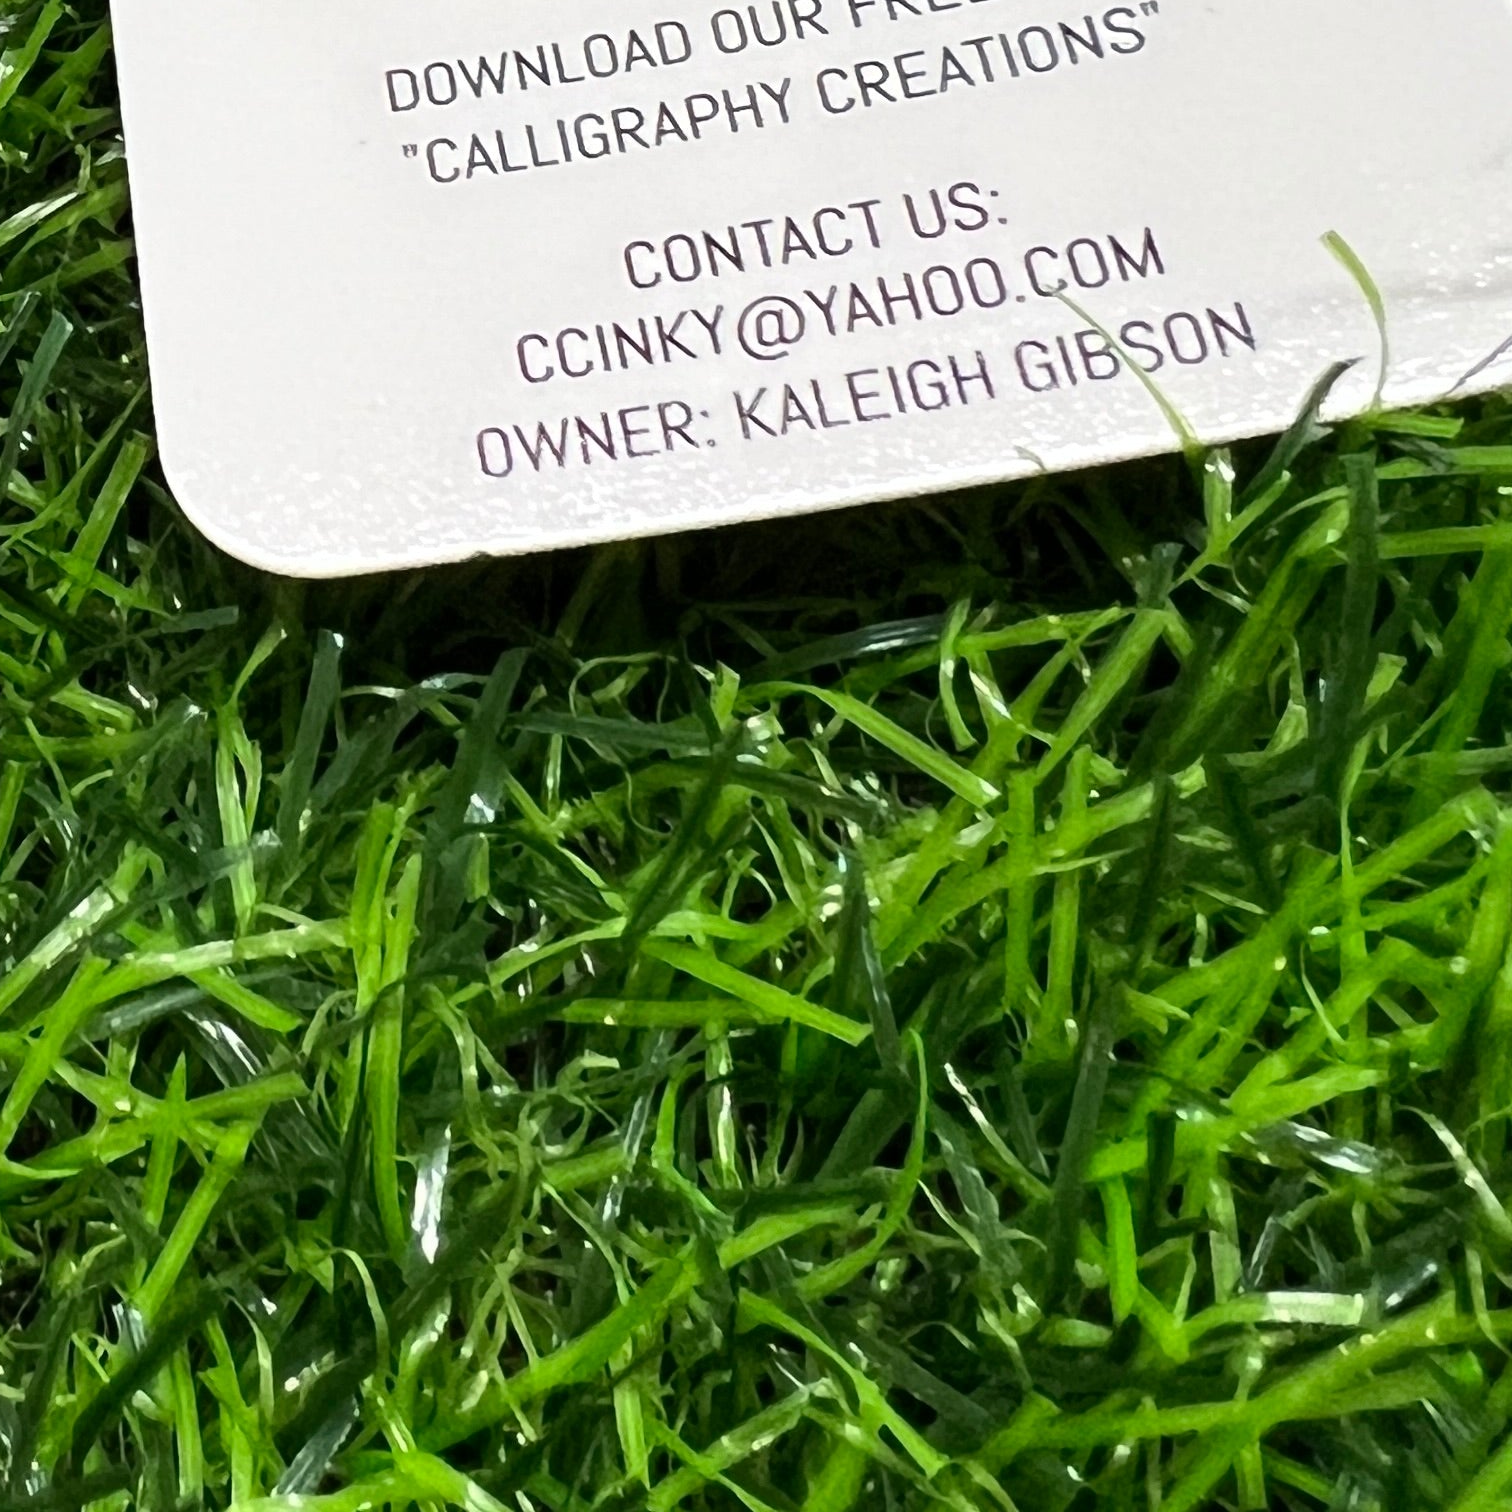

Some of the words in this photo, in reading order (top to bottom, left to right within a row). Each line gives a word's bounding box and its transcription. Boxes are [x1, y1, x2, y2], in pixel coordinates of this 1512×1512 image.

[383, 19, 694, 114] DOWNLOAD
[400, 76, 793, 185] "CALLIGRAPHY
[622, 198, 883, 291] CONTACT
[900, 180, 1009, 240] US:
[515, 225, 1167, 385] CCINKY@YAHOO.COM
[475, 399, 718, 480] OWNER:
[731, 348, 997, 442] KALEIGH
[1012, 300, 1258, 394] GIBSON
